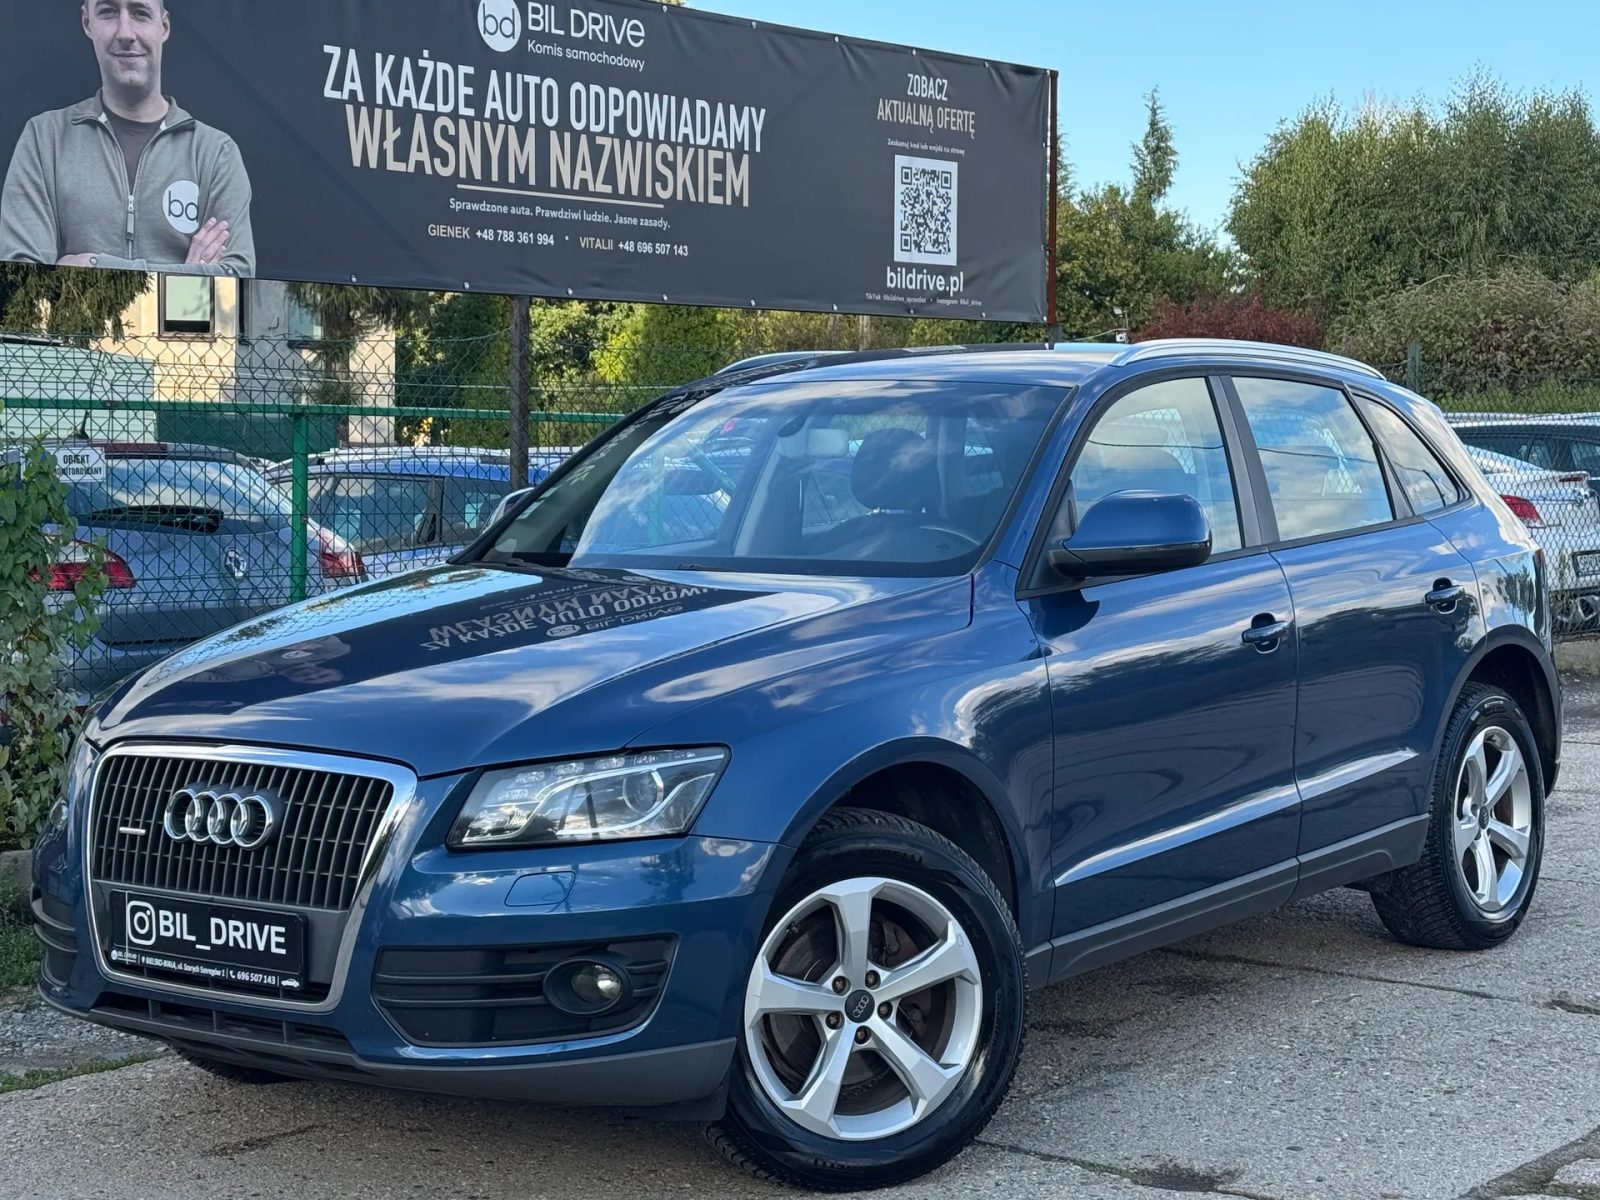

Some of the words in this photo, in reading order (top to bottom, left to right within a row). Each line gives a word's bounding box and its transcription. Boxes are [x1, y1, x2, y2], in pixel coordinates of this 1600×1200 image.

[527, 1, 565, 36] BIL
[527, 39, 563, 57] Komis
[565, 47, 645, 72] samochodowy
[323, 44, 365, 103] ZA
[375, 49, 476, 117] KAŻDE
[484, 69, 559, 127] AUTO
[569, 81, 767, 153] ODPOWIADAMY
[906, 73, 949, 101] ZOBACZ
[876, 97, 935, 134] AKTUALNĄ
[937, 109, 976, 139] OFERTĘ
[345, 103, 537, 186] WŁASNYM
[549, 129, 750, 208] NAZWISKIEM
[449, 197, 509, 213] Sprawdzone
[510, 205, 533, 216] auta.
[535, 206, 581, 220] Prawdziwi
[583, 210, 612, 223] ludzie.
[613, 213, 638, 226] Jasne
[639, 217, 671, 231] zasady.
[427, 223, 471, 240] GIENEK
[476, 228, 495, 241] +48
[496, 229, 515, 243] 788
[517, 231, 534, 244] 361
[536, 233, 555, 246] 994
[579, 236, 614, 251] VITALII
[618, 240, 635, 252] +48
[637, 241, 653, 254] 696
[655, 242, 671, 255] 507
[673, 244, 689, 257] 143
[886, 266, 964, 297] bildrive.pl
[56, 466, 102, 475] ONITOROWANY
[158, 909, 287, 955] BIL_DRIVE
[236, 970, 250, 980] 696
[250, 972, 263, 982] 507
[263, 974, 276, 985] 143
